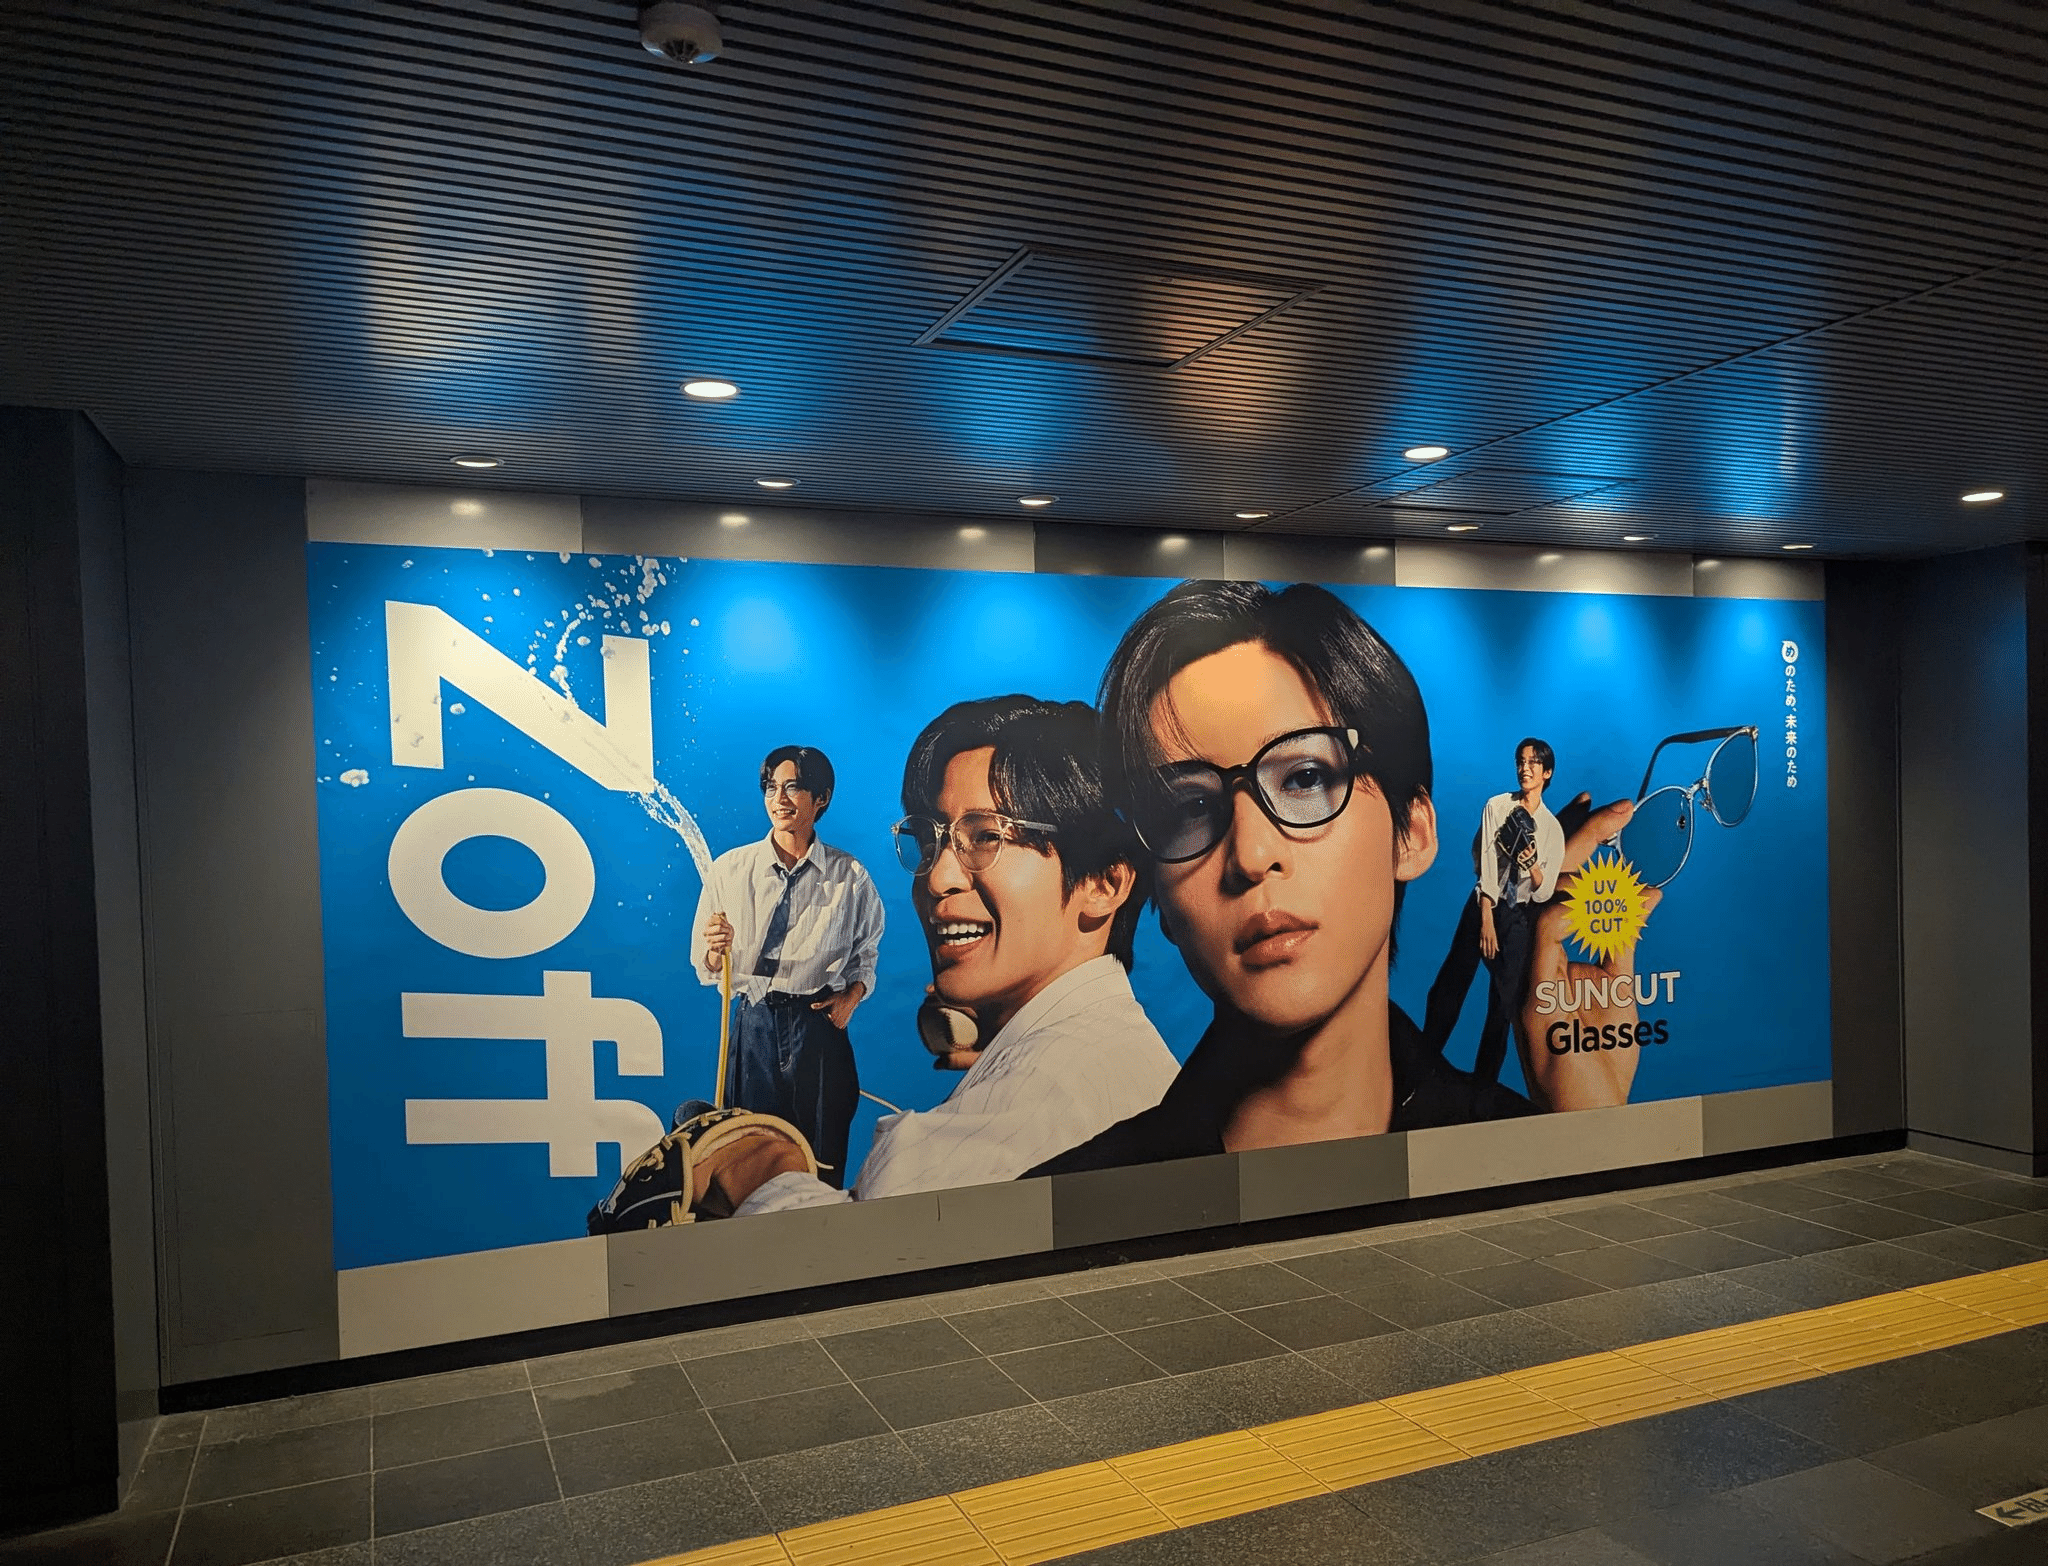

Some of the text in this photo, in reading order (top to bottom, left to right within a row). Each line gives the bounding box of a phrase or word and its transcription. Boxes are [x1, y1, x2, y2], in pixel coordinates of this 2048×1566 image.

[1782, 641, 1798, 788] めのため、未来のため
[385, 600, 665, 1178] Zoff
[1584, 898, 1628, 915] 100%
[1594, 879, 1618, 895] UV
[1535, 970, 1681, 1015] SUNCUT
[1545, 1018, 1669, 1056] Glasses
